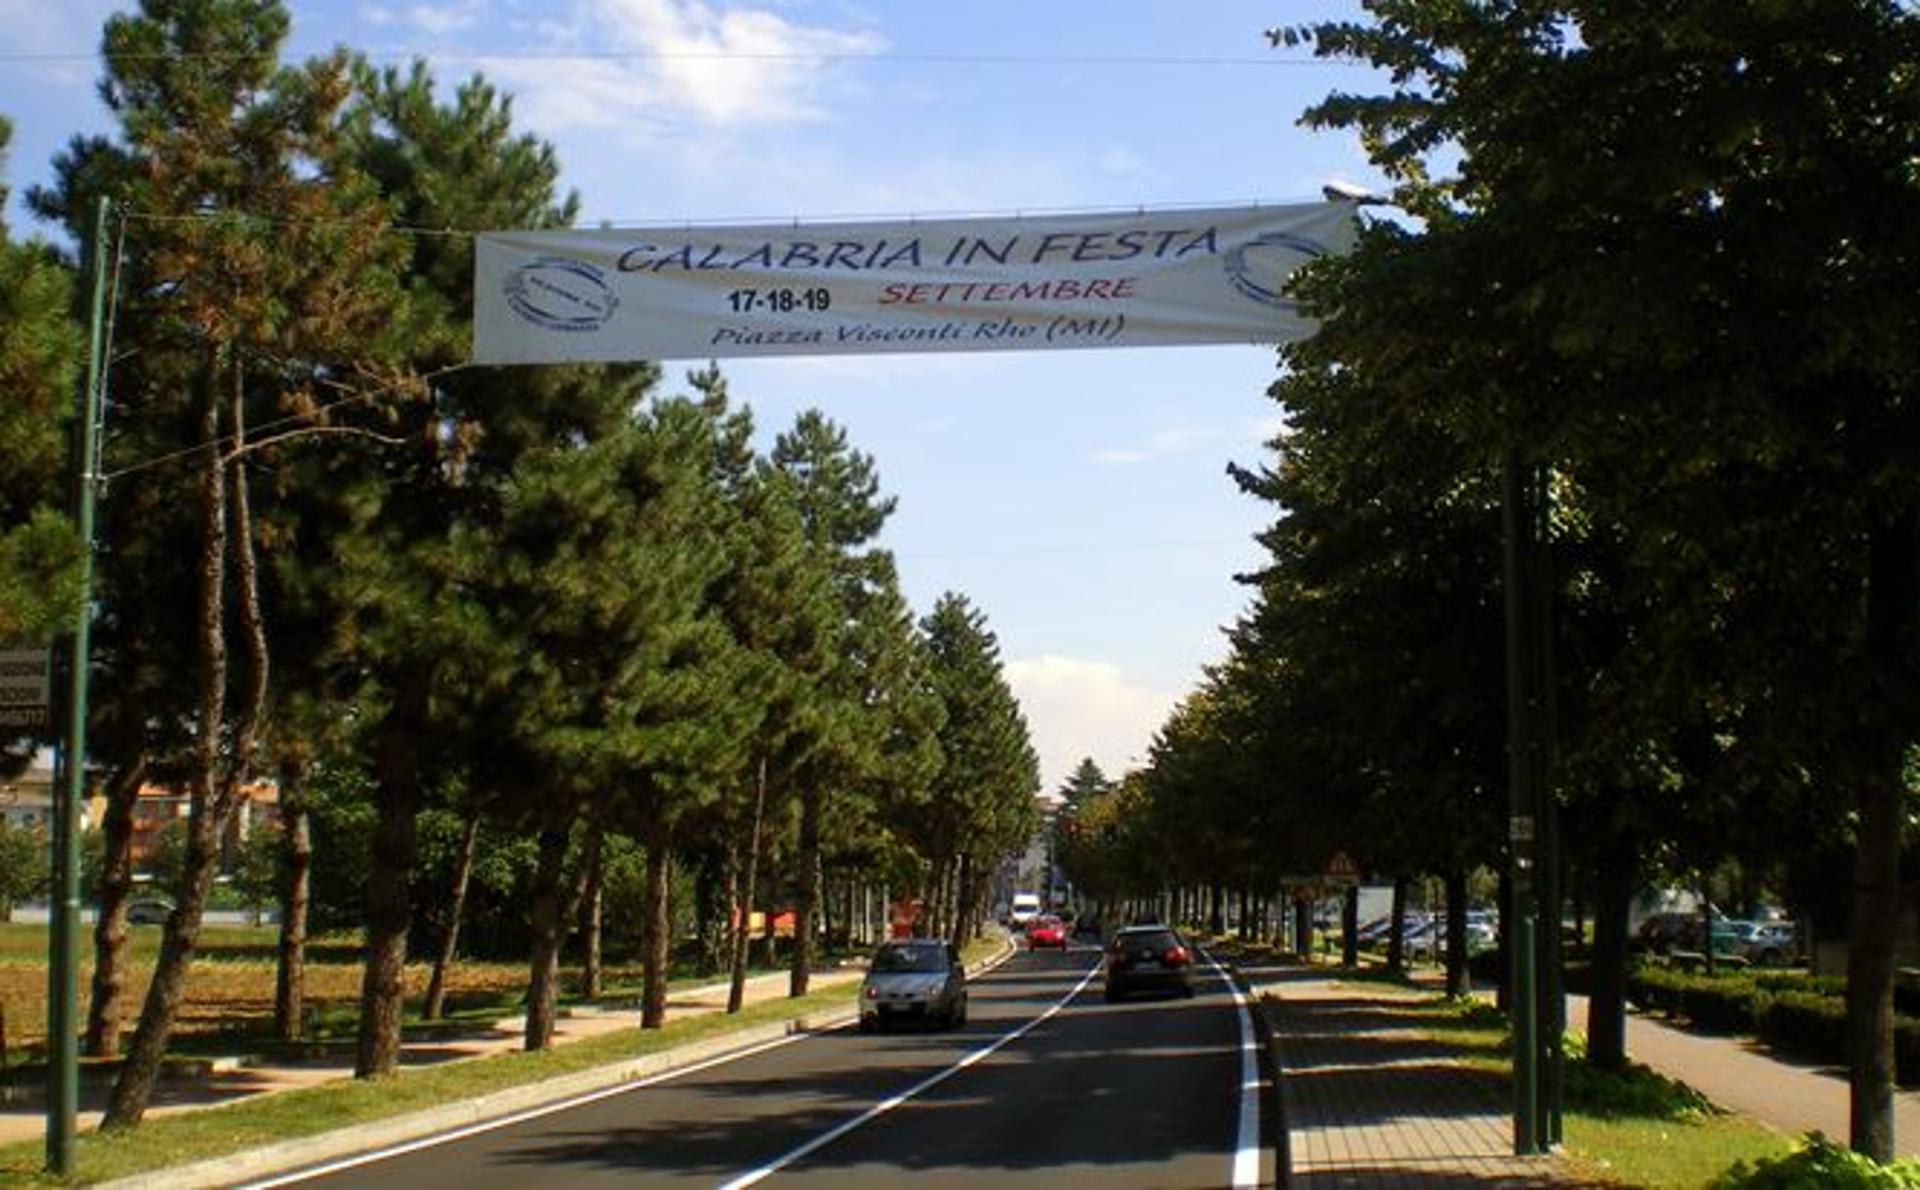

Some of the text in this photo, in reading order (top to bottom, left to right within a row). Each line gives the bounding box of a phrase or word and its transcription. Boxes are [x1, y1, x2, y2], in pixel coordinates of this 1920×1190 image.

[616, 227, 1217, 272] CALABRIA IN FESTA
[728, 276, 1138, 313] 17-18-19 SETTEMBRE
[711, 312, 1125, 345] Piazza Visconti Rho (MI)
